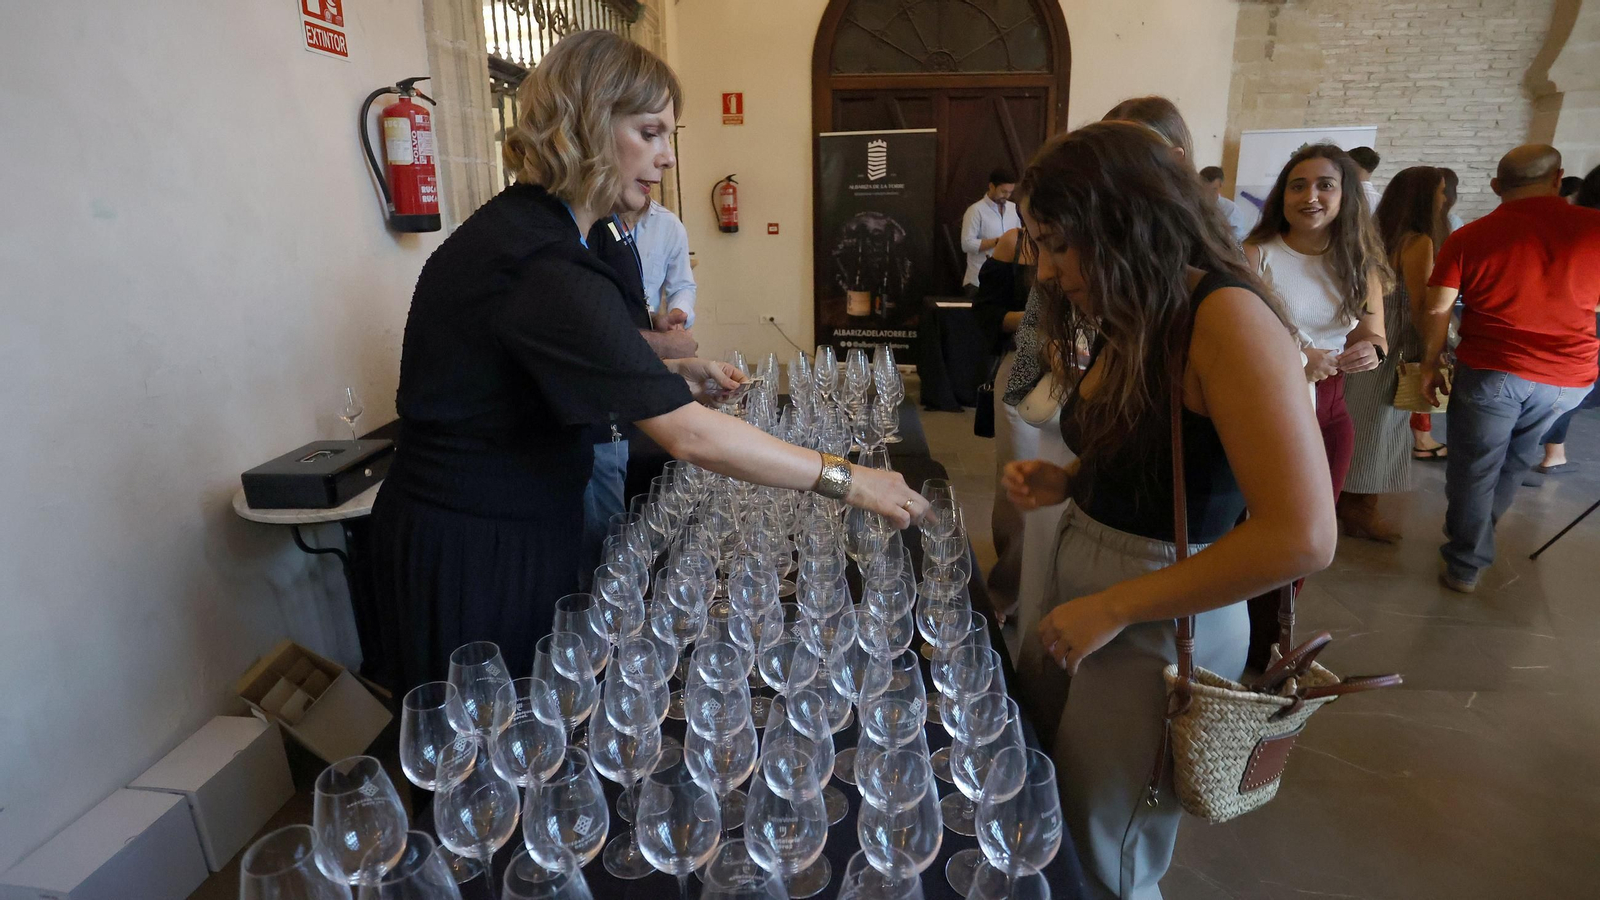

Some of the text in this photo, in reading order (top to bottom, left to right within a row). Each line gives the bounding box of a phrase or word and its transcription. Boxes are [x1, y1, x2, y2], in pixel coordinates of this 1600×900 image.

[305, 25, 347, 53] EXTINTOR
[411, 130, 420, 165] POLVO
[833, 329, 918, 338] ALBARIZADELATORRE.ES
